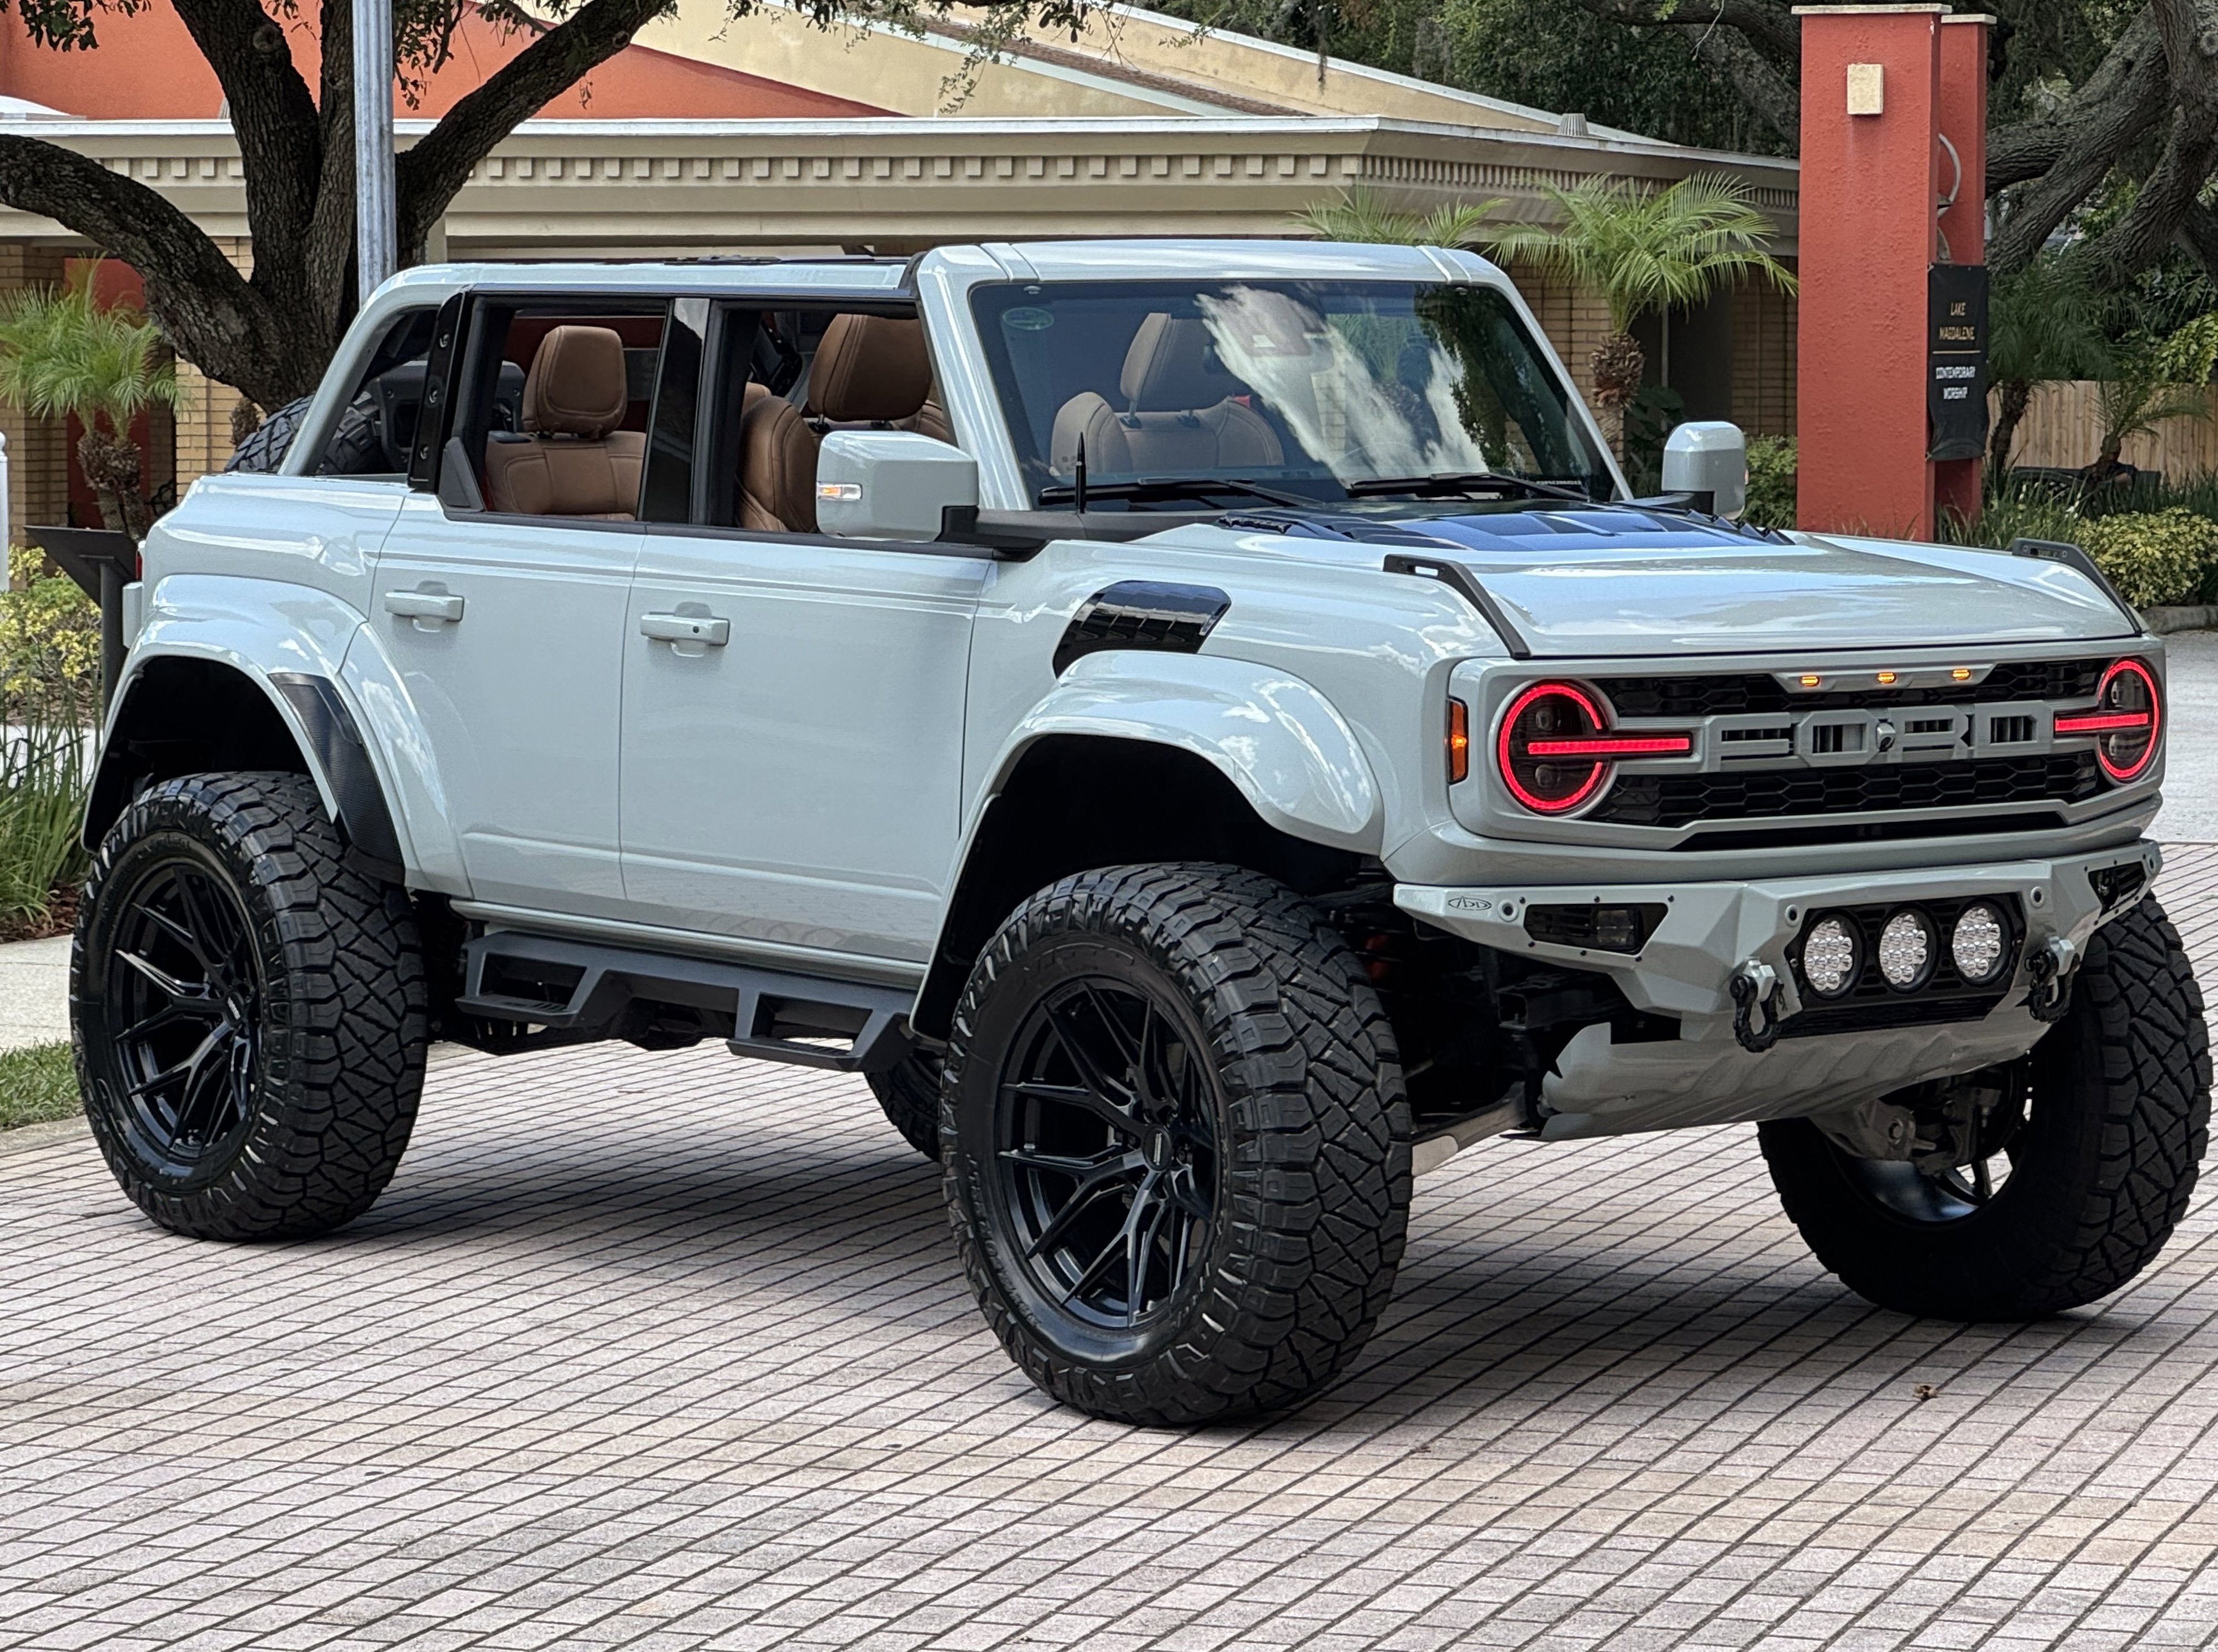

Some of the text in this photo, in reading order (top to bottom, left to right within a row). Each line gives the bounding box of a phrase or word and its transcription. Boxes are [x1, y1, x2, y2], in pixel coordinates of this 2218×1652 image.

[1950, 302, 1966, 316] LAKE
[1939, 326, 1975, 340] MAGDALENE
[1703, 699, 2053, 772] FORD
